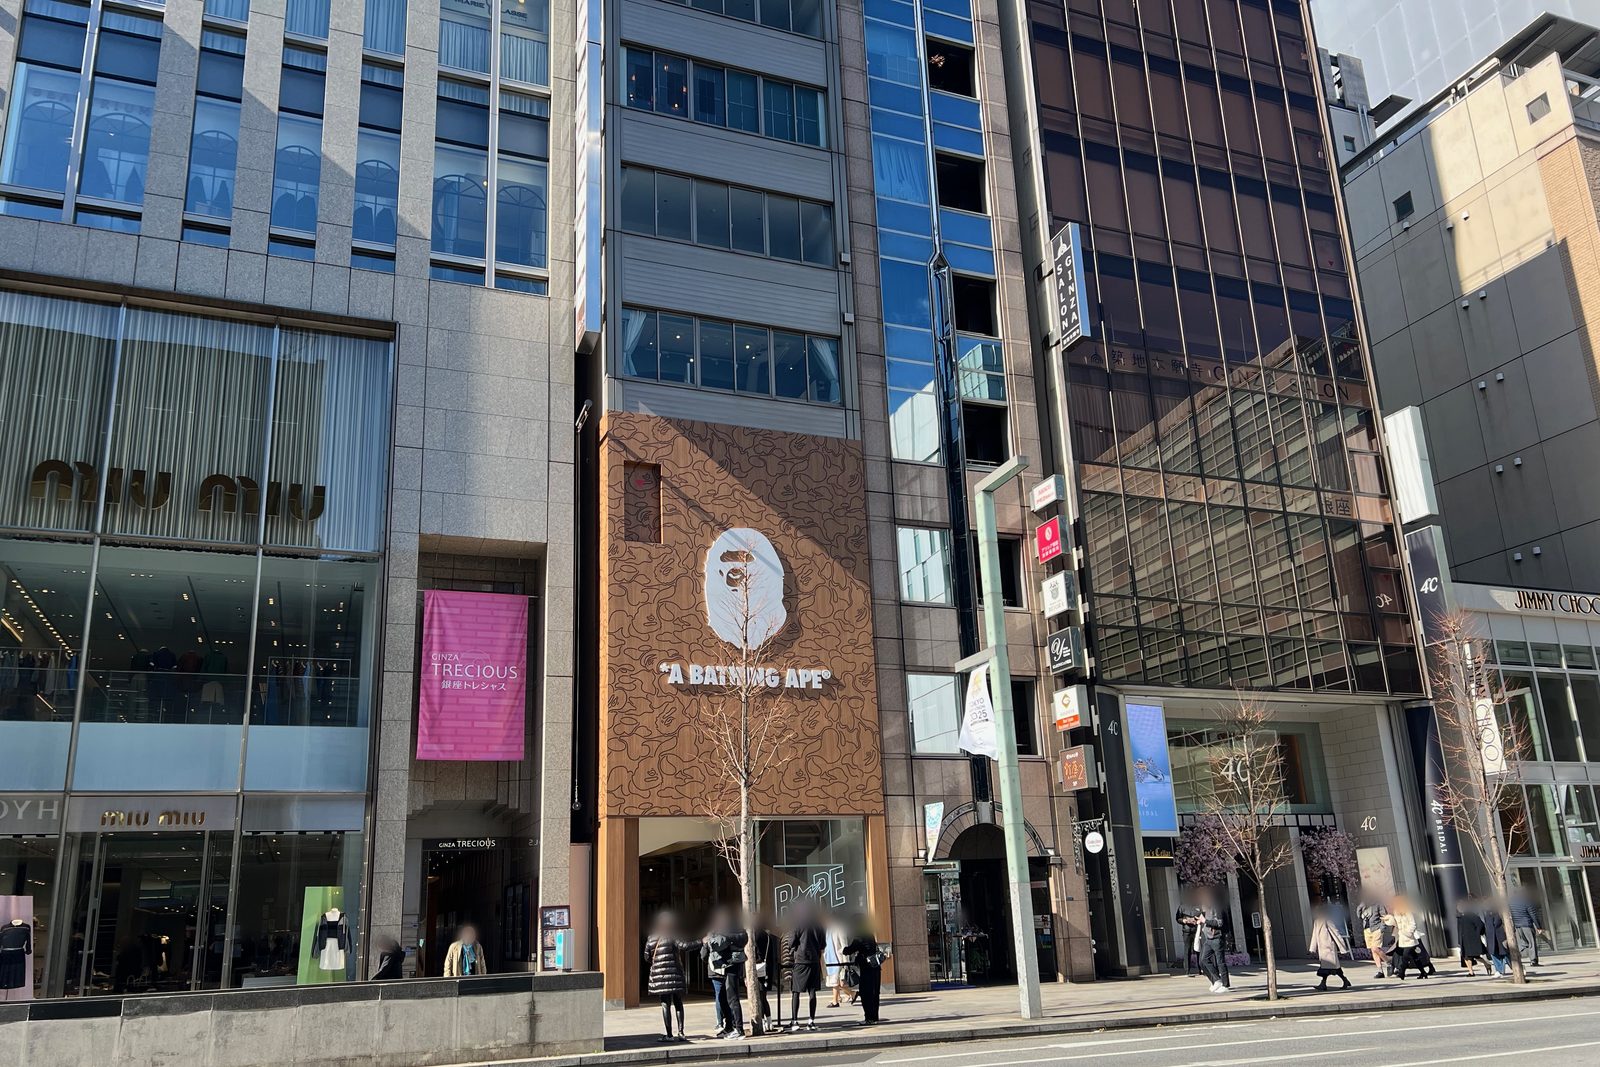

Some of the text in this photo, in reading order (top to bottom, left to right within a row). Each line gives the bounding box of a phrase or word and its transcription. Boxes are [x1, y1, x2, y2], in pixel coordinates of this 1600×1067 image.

[1057, 264, 1069, 331] SALON
[1065, 255, 1078, 323] GINZA
[1515, 591, 1555, 611] JIMMY
[431, 653, 459, 661] GINZA
[431, 663, 518, 679] TRECIOUS
[441, 680, 507, 691] 銀座トレシャス
[1436, 820, 1448, 854] BRIDAL
